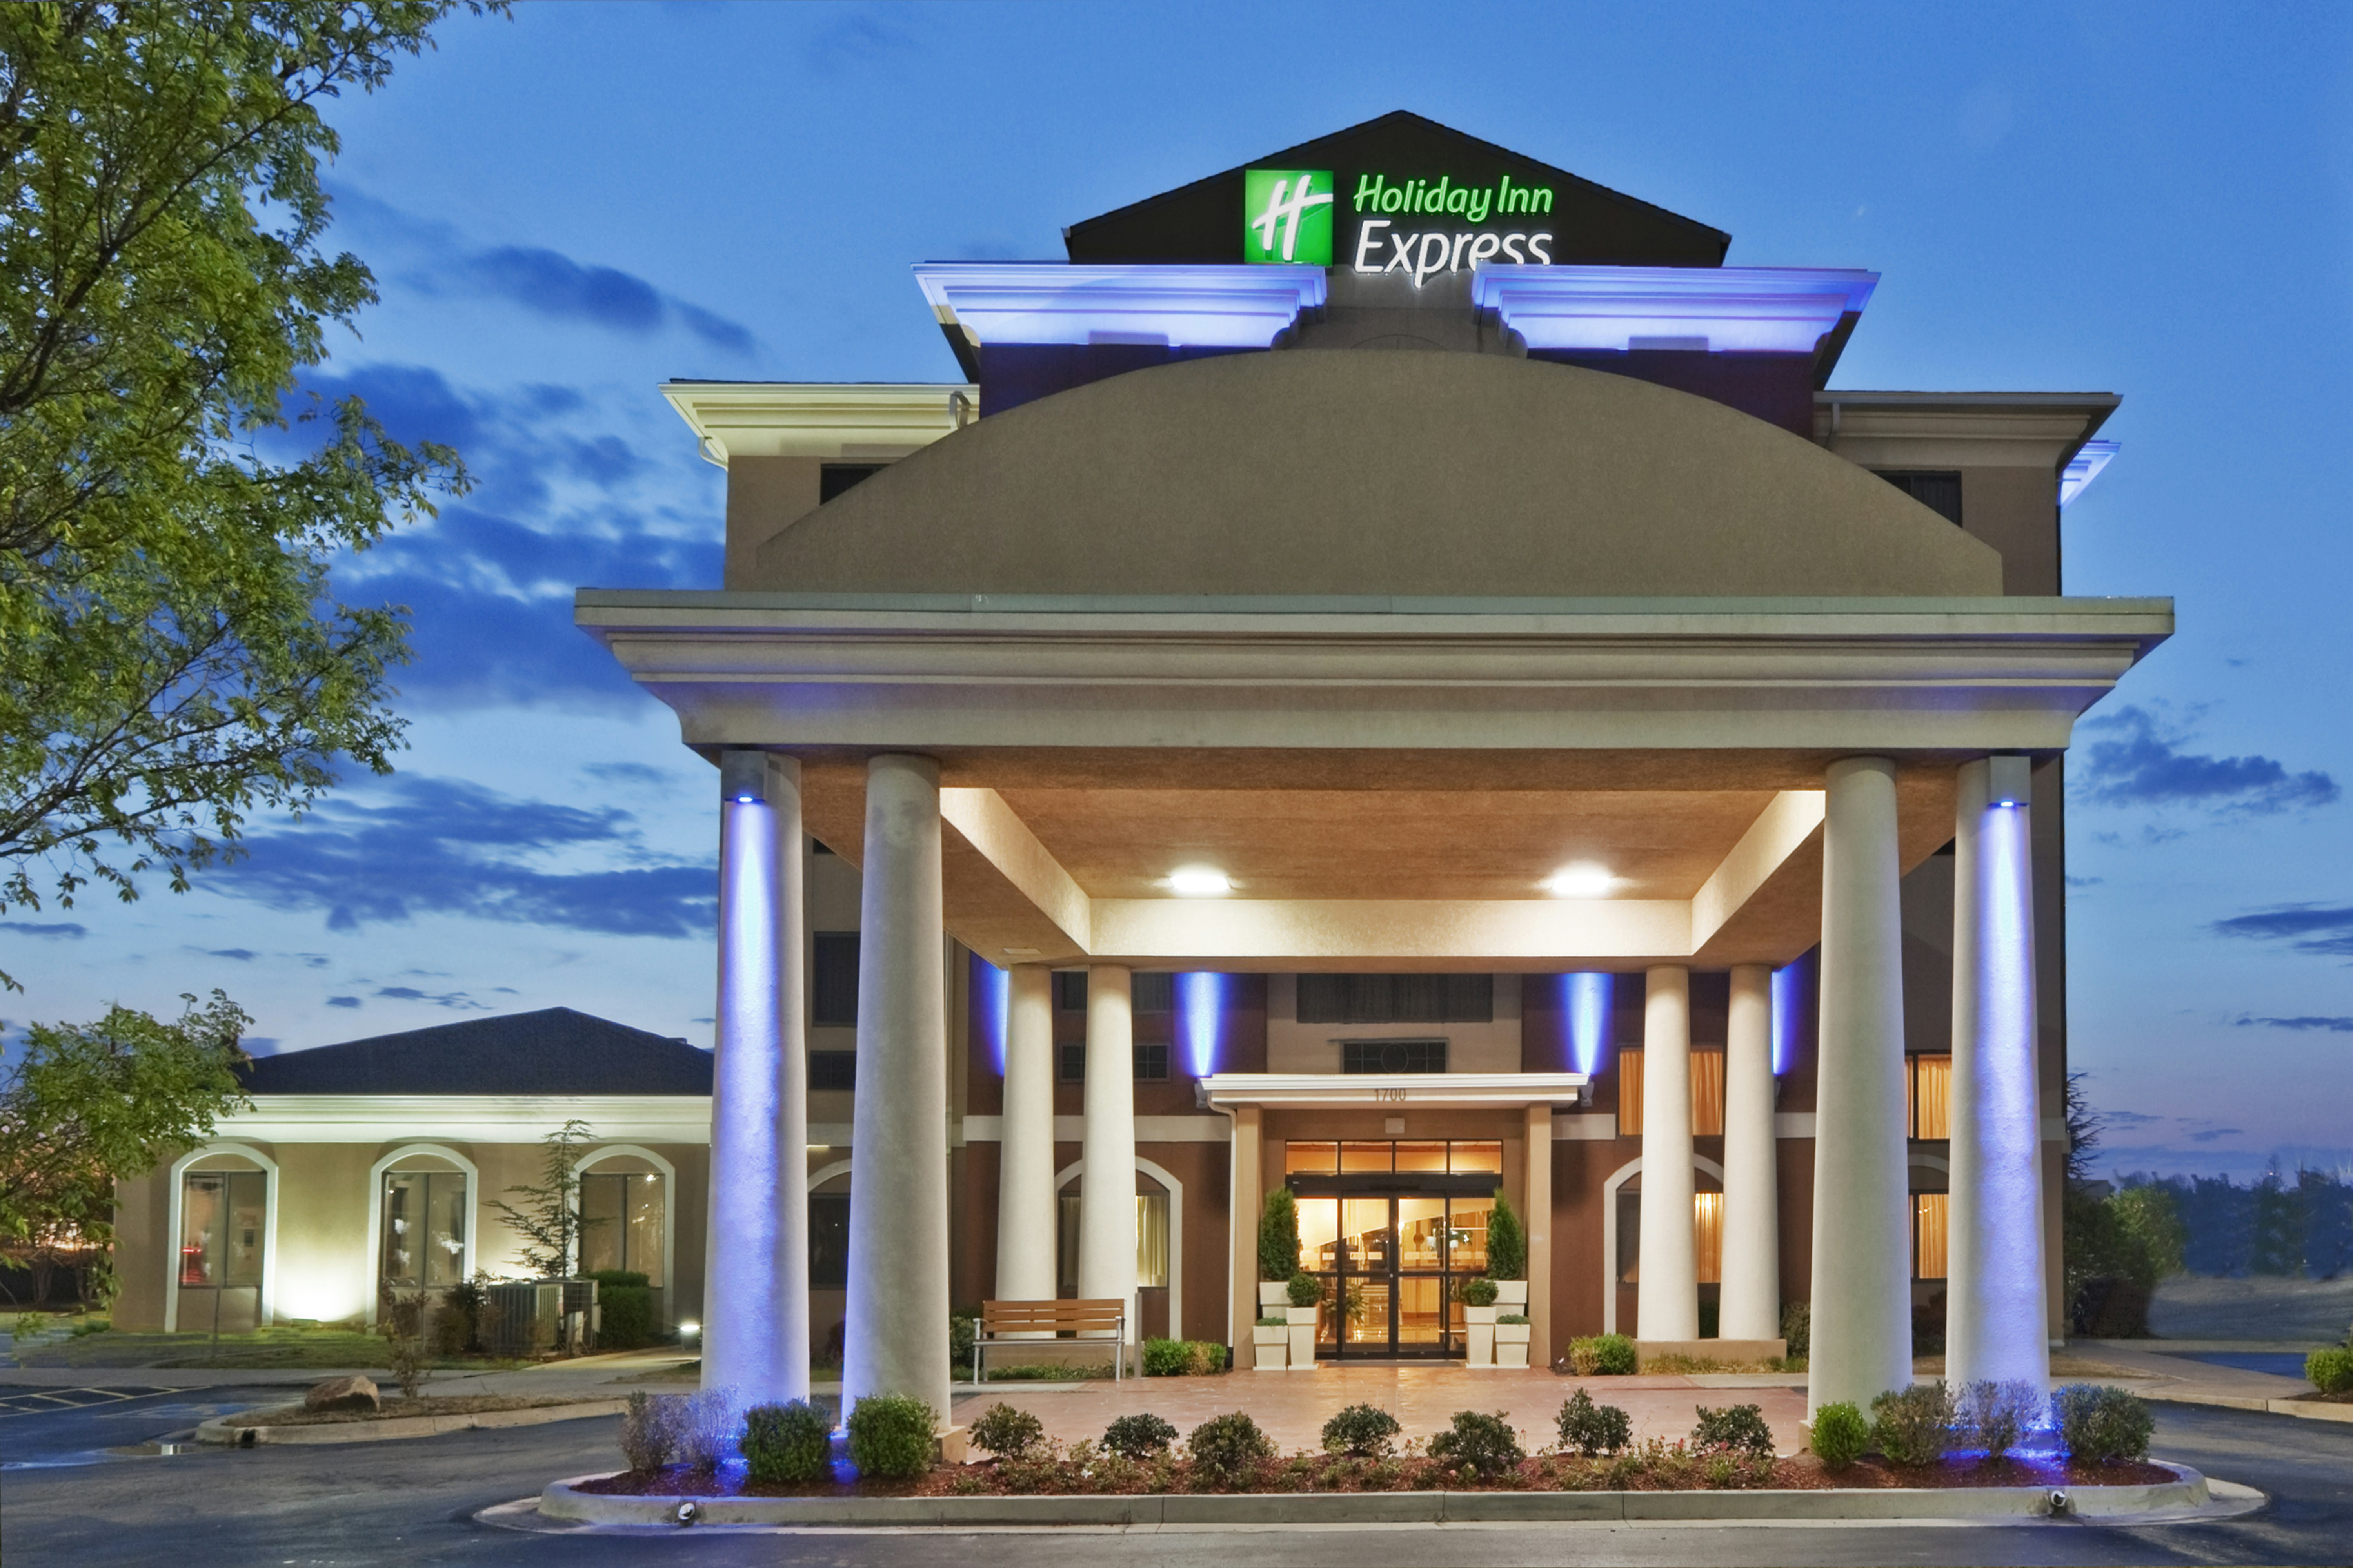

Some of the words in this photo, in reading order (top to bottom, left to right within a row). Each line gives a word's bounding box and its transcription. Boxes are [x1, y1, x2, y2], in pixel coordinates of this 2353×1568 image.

[1252, 175, 1333, 261] H
[1354, 175, 1491, 222] Holiday
[1497, 176, 1553, 213] Inn
[1354, 220, 1553, 289] Express
[1375, 1088, 1406, 1102] 1700
